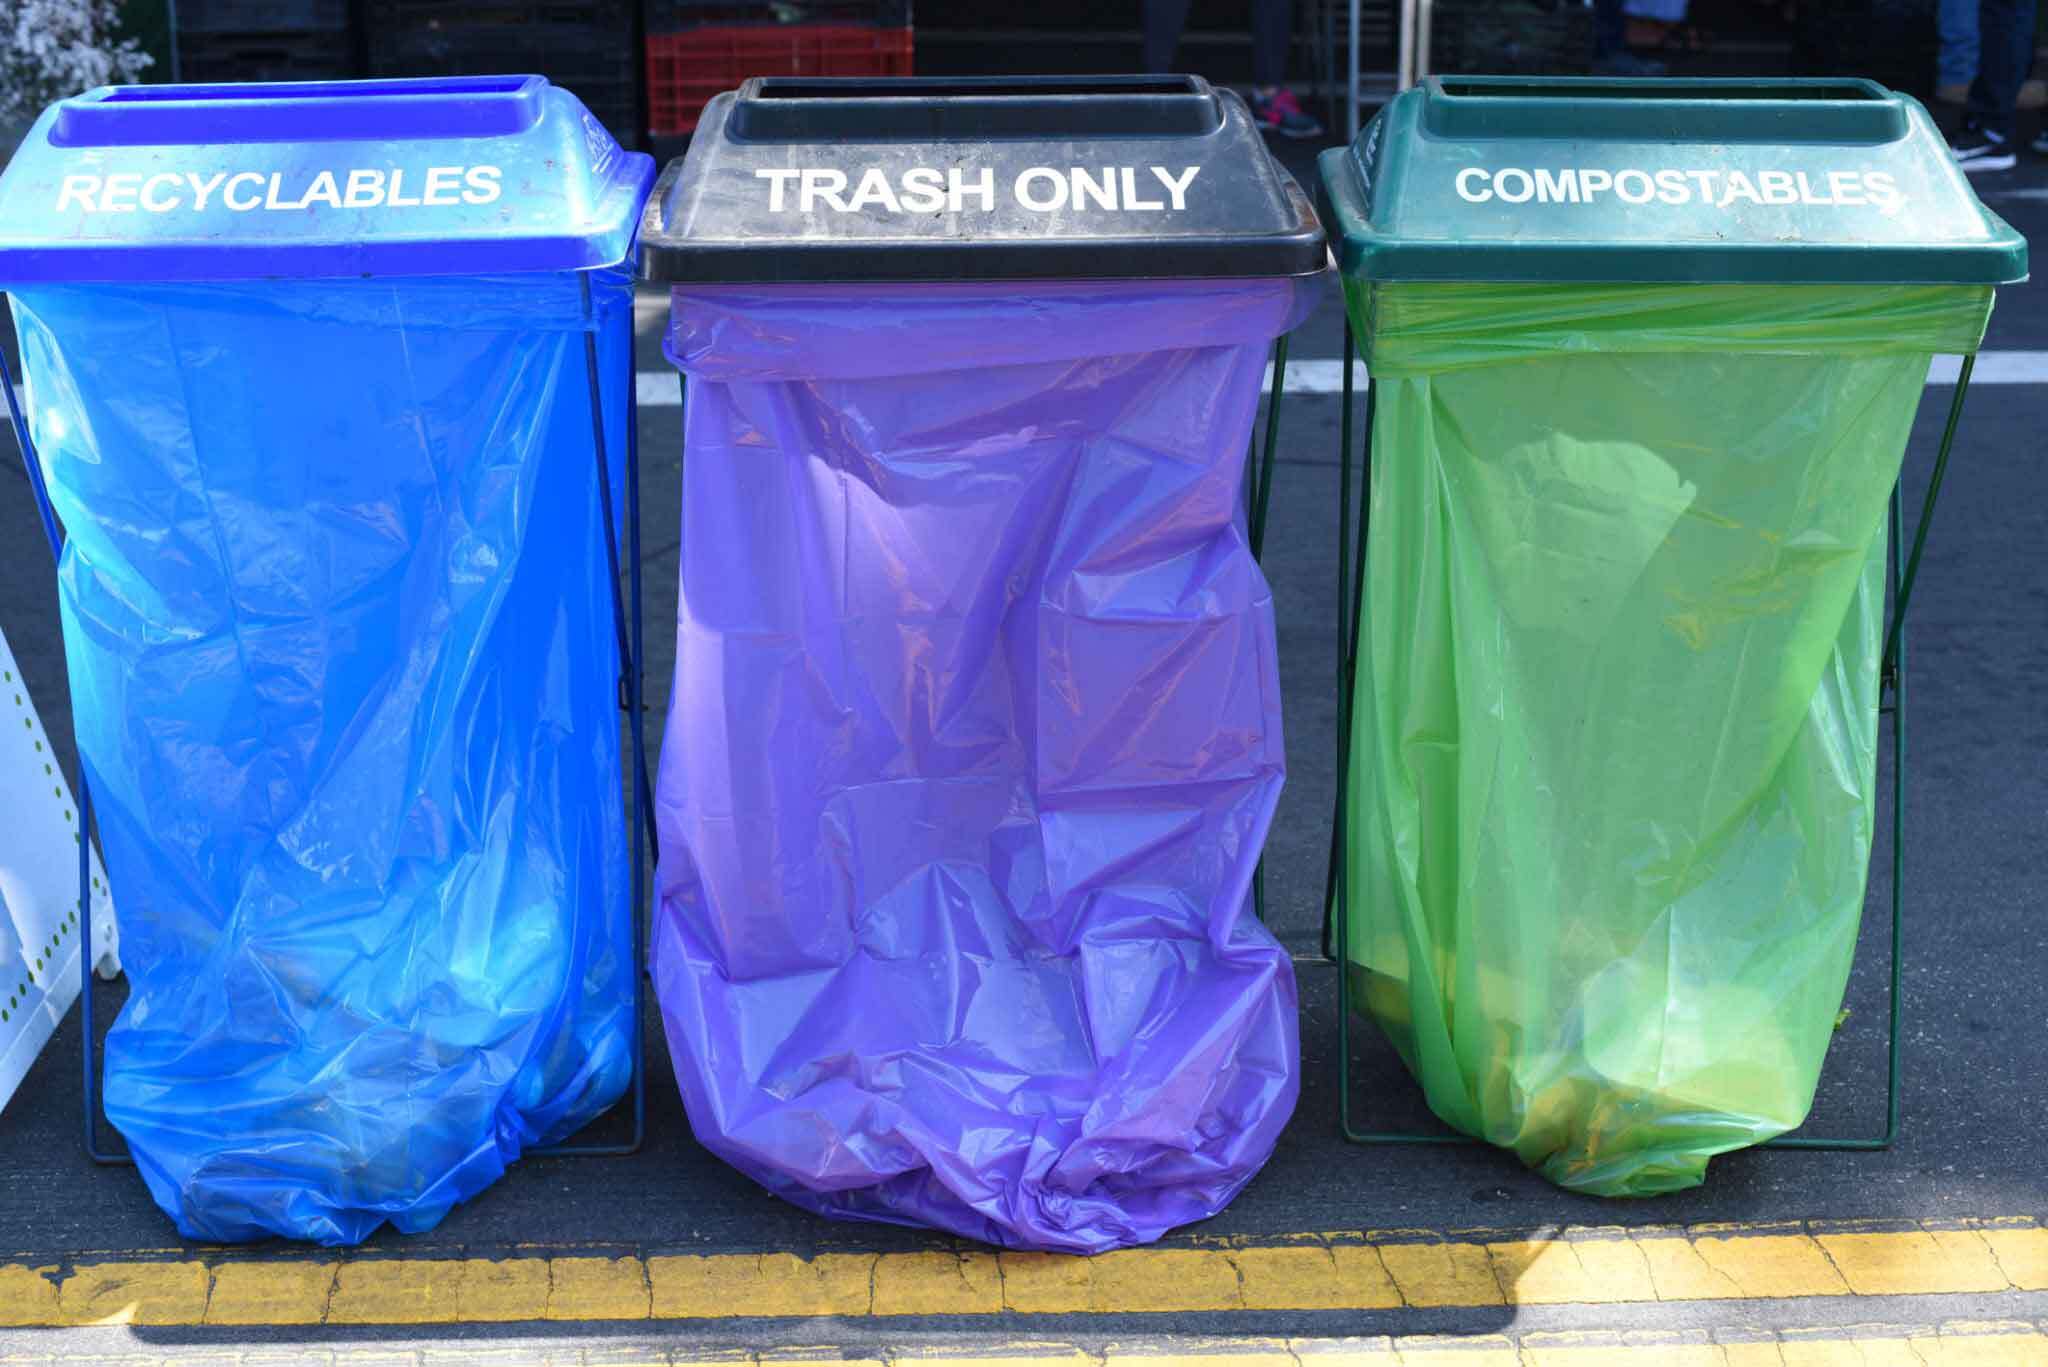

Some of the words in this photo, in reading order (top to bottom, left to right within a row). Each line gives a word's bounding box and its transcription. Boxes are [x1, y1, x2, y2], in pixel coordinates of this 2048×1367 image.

[55, 165, 502, 212] RECYCLABLES
[756, 167, 994, 212] TRASH
[1014, 166, 1201, 211] ONLY
[1455, 167, 1900, 207] COMPOSTABLES
